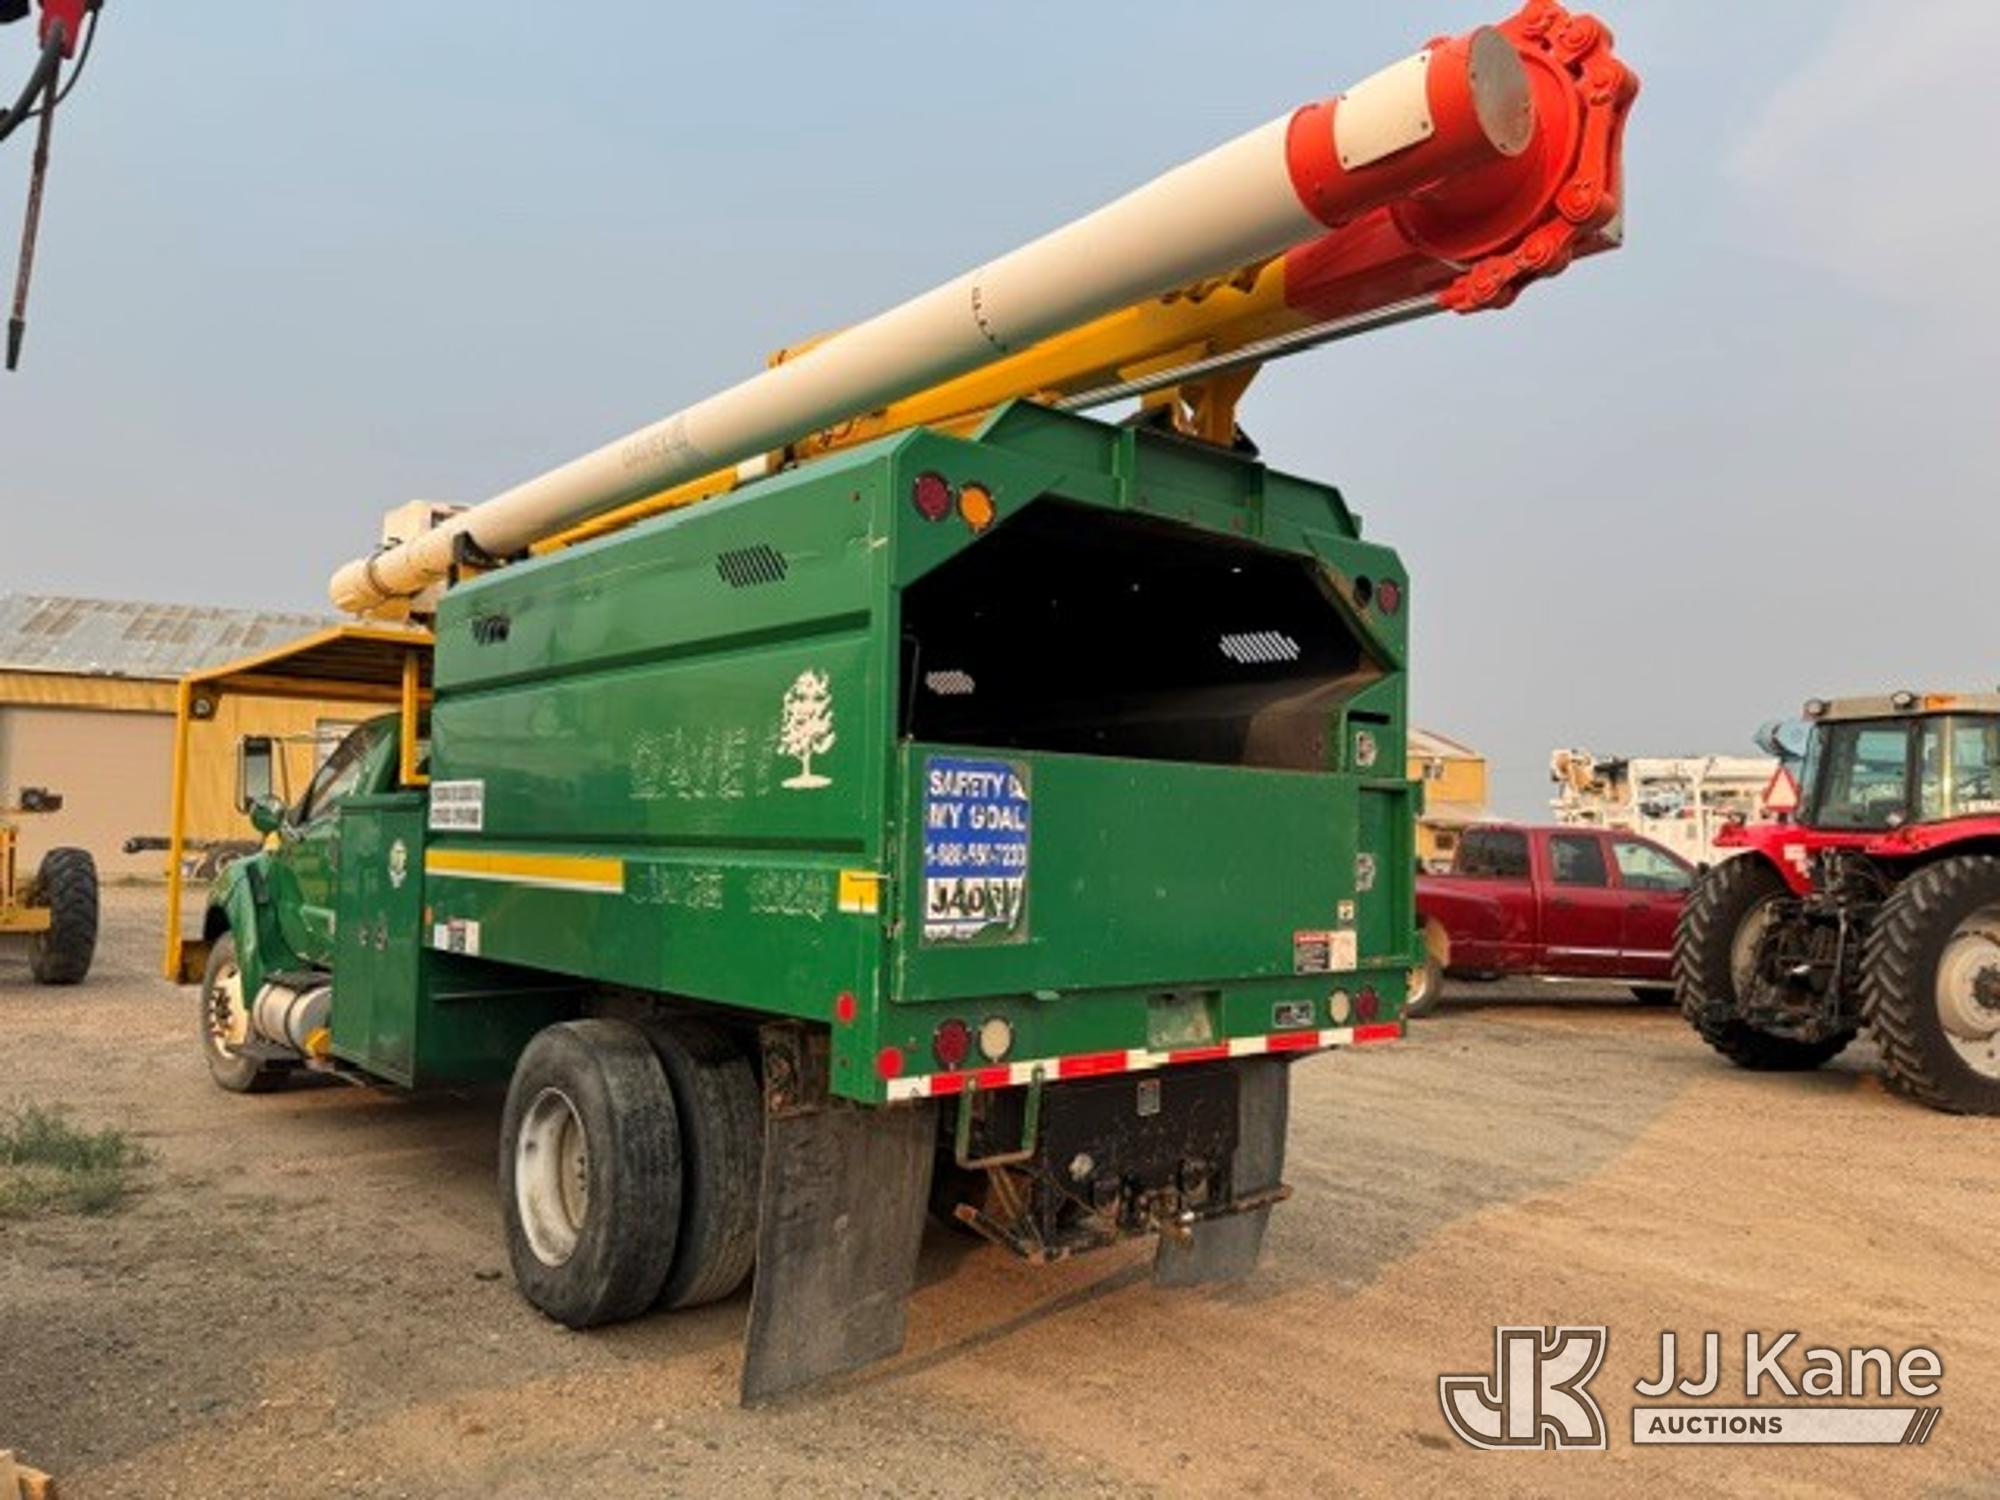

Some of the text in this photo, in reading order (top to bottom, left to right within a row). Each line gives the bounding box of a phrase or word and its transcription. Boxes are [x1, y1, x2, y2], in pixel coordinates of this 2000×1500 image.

[930, 769, 1004, 798] SAFETY
[929, 803, 1025, 830] MY GOAL
